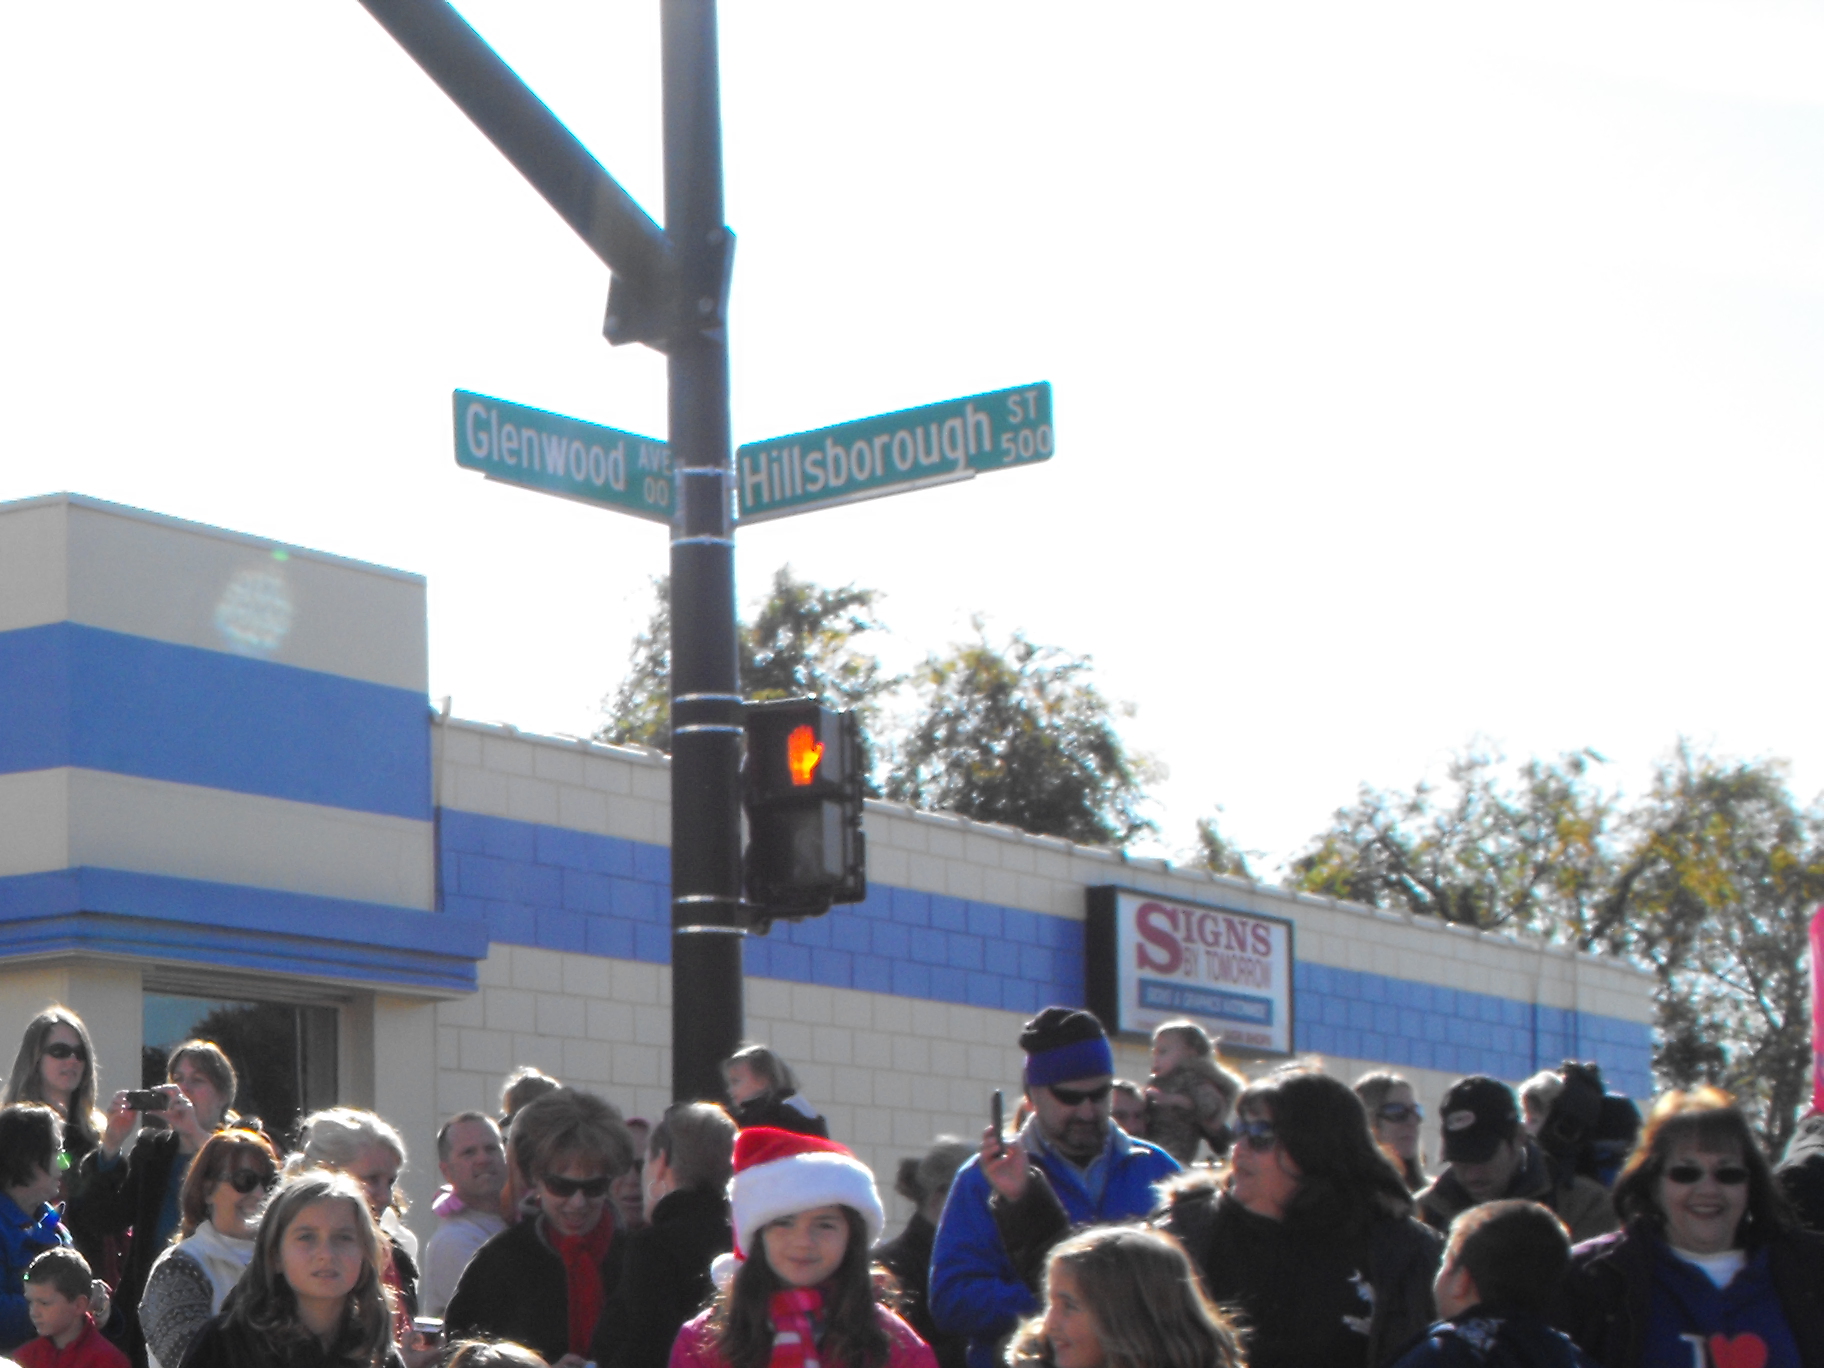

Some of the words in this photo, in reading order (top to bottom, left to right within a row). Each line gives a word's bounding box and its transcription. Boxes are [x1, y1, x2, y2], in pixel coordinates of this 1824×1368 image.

[465, 403, 627, 492] Glenwood
[638, 443, 672, 475] AVE
[741, 405, 993, 507] Hillsborough
[1007, 390, 1039, 424] ST
[1000, 423, 1053, 464] 500
[1135, 901, 1273, 975] SIGNS
